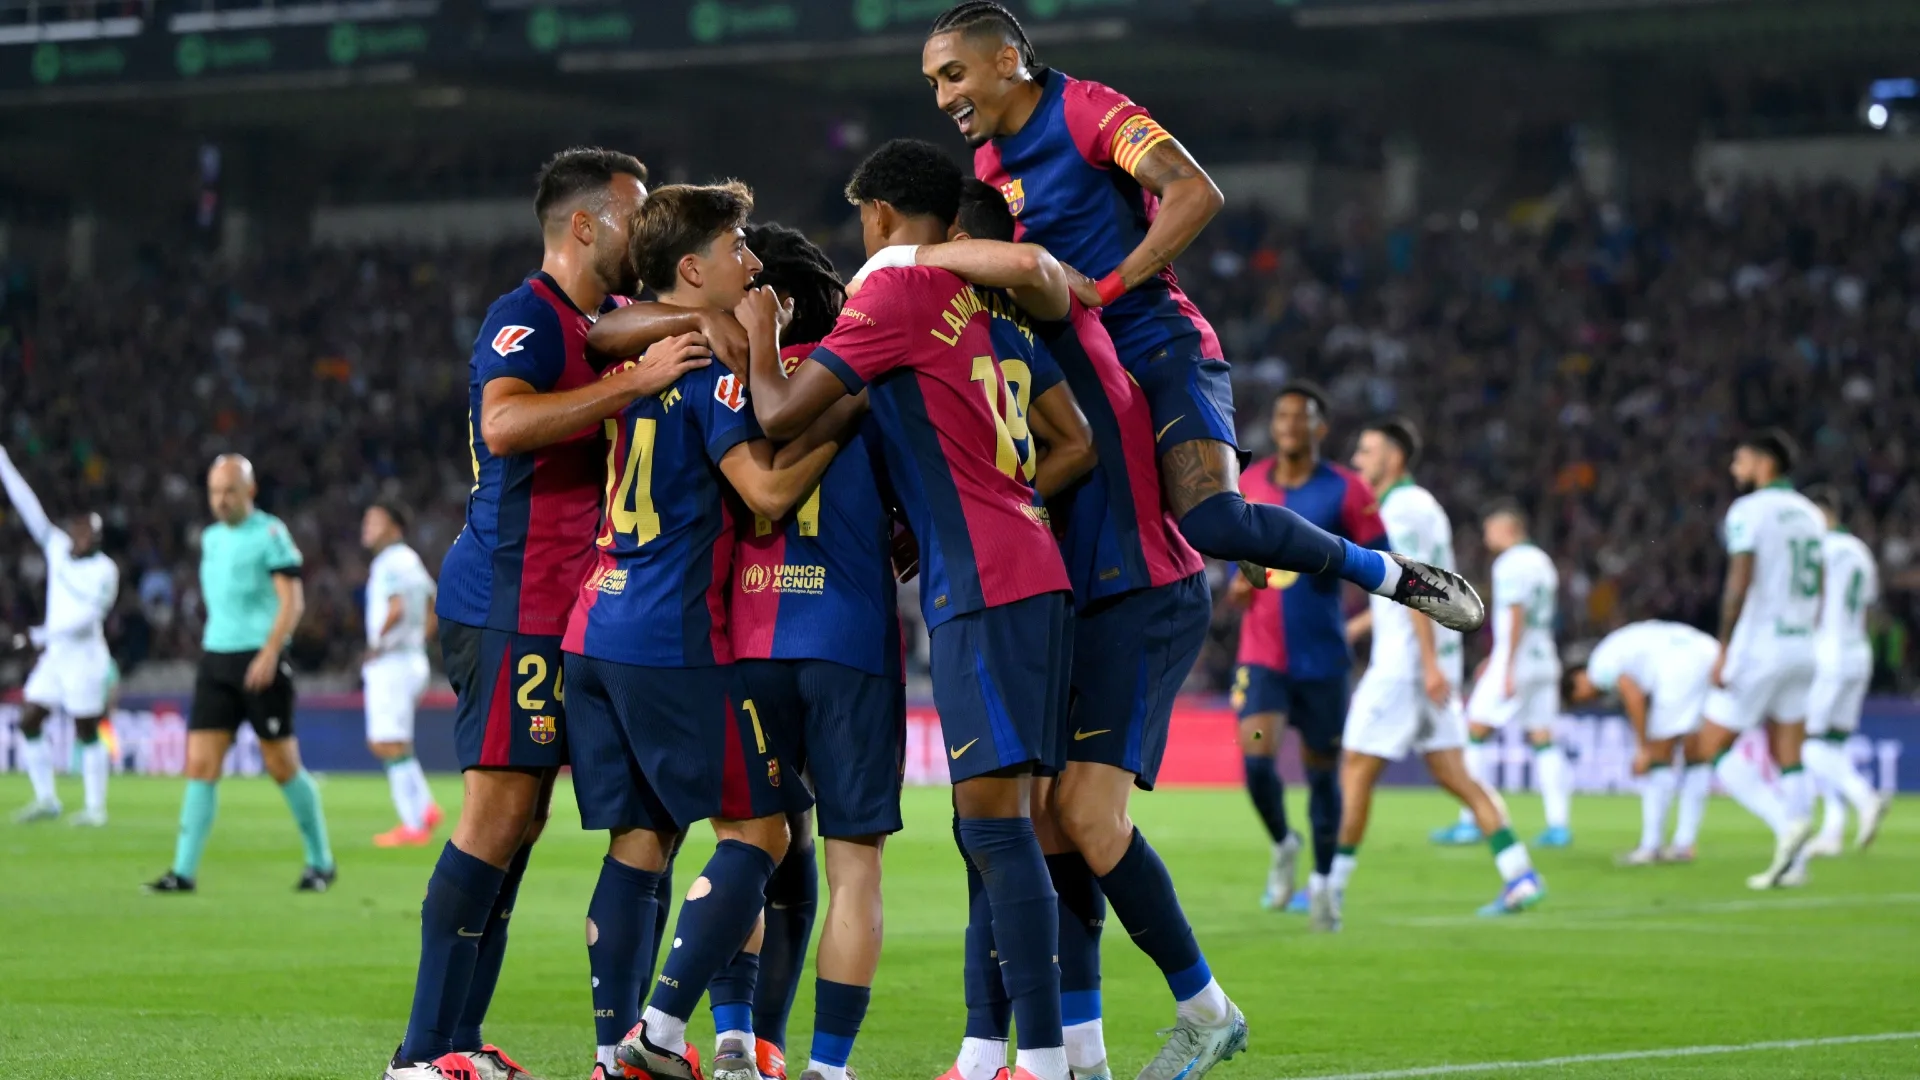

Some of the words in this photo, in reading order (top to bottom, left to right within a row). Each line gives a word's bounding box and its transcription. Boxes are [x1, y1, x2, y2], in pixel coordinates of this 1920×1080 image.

[970, 355, 1037, 482] 19
[596, 418, 661, 547] 14
[772, 576, 825, 590] ACNUR
[773, 564, 826, 578] UNHCR
[1787, 536, 1822, 601] 15
